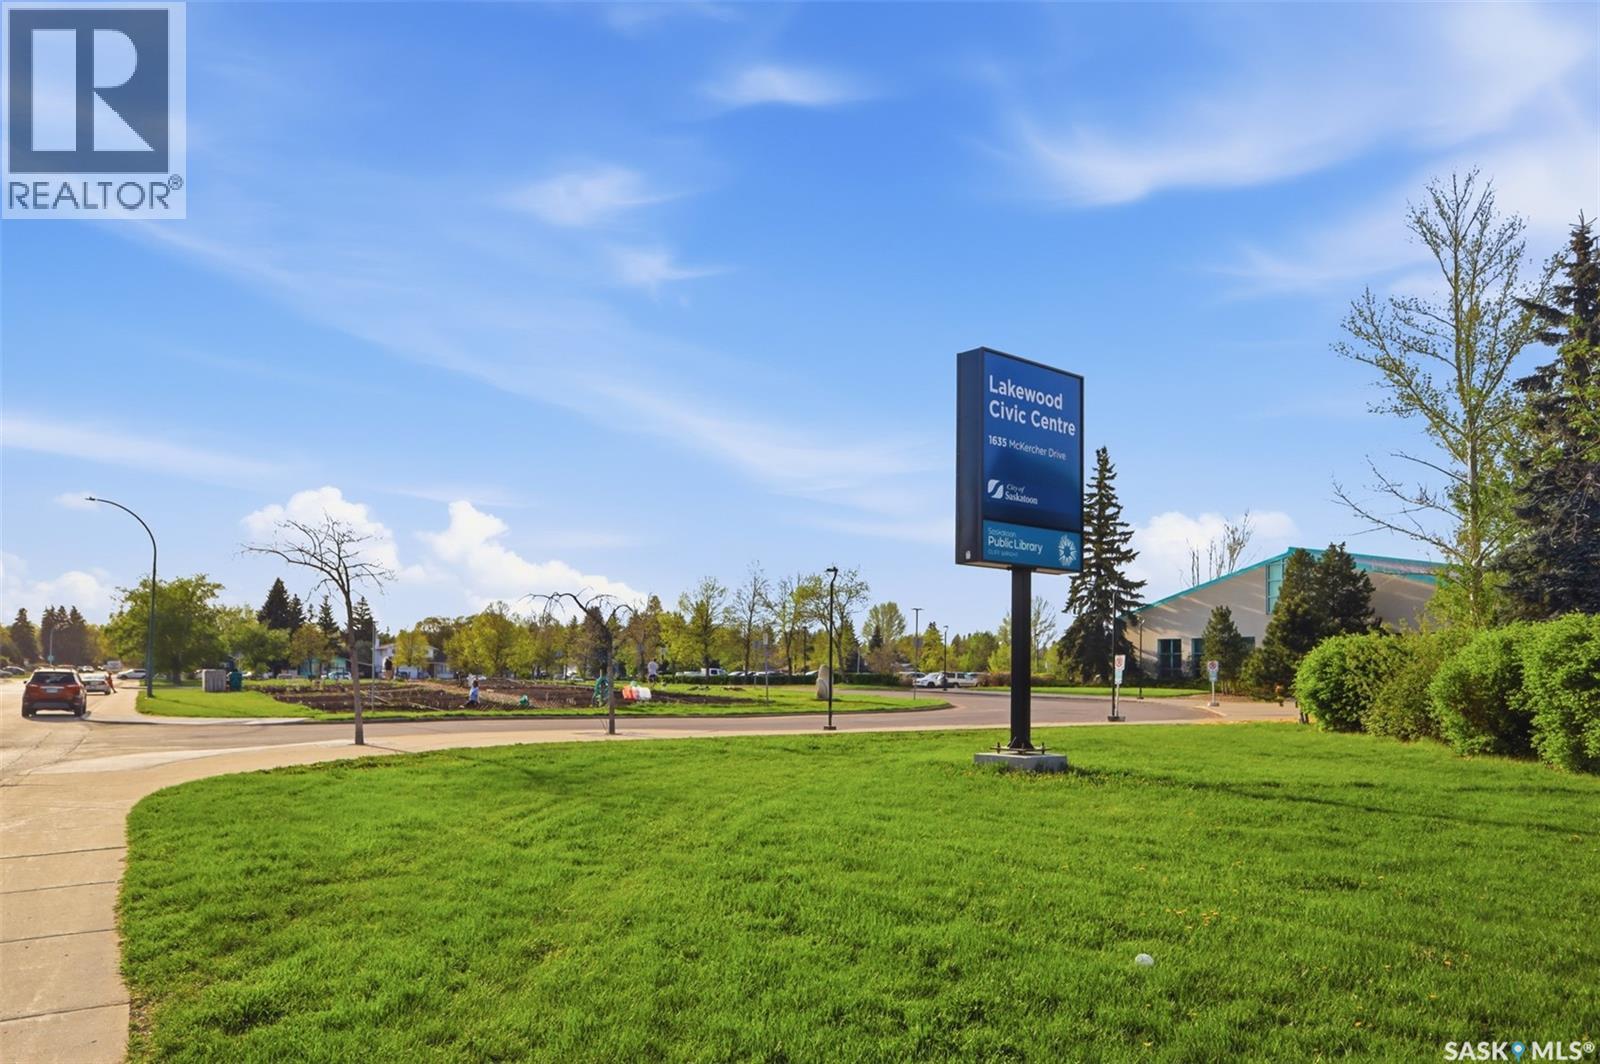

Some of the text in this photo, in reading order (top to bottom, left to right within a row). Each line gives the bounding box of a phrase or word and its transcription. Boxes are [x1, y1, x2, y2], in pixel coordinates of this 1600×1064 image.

[989, 374, 1063, 411] Lakewood
[989, 399, 1077, 436] Civic Centre
[988, 435, 1067, 461] 1635 McKercher Drive
[1005, 490, 1039, 505] Saskatoon
[1006, 483, 1026, 494] City of
